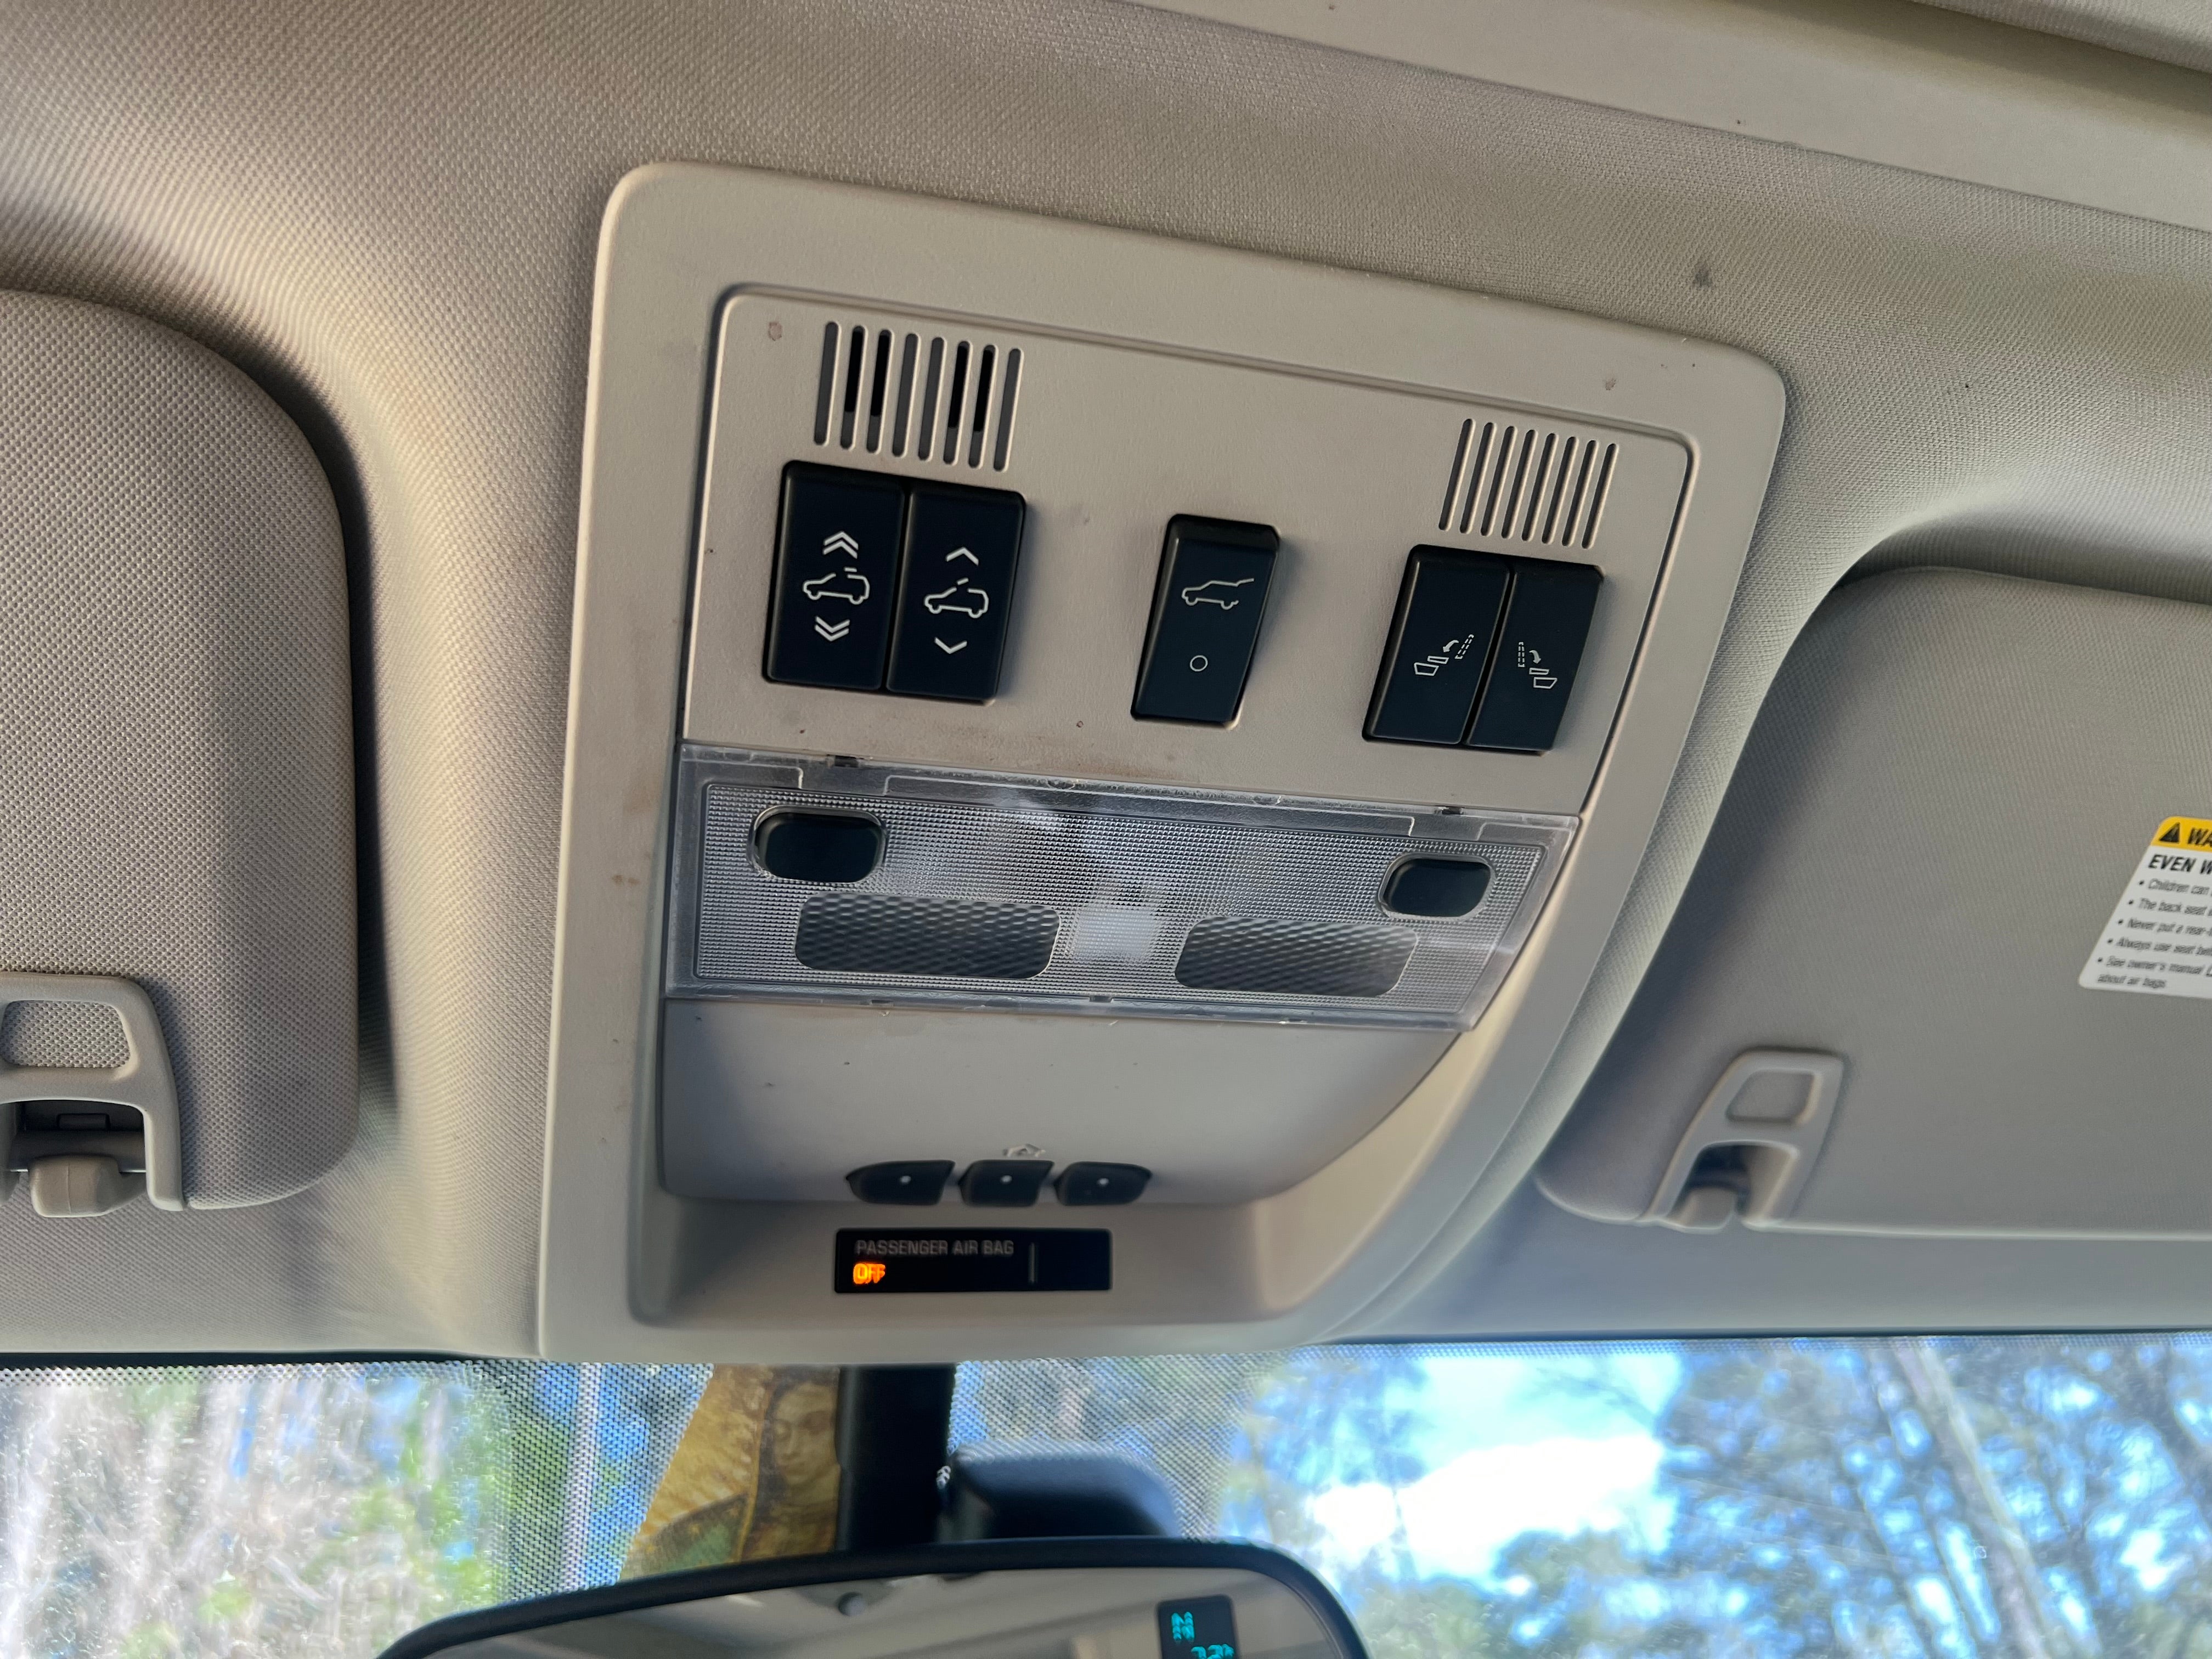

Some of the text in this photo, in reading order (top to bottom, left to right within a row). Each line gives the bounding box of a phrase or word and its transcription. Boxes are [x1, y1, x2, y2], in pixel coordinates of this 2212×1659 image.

[2148, 854, 2196, 872] EVEN
[2138, 898, 2157, 910] The
[855, 1239, 1014, 1256] PASSENGER AIR BAG
[853, 1263, 886, 1284] OFF
[1171, 1611, 1195, 1642] N
